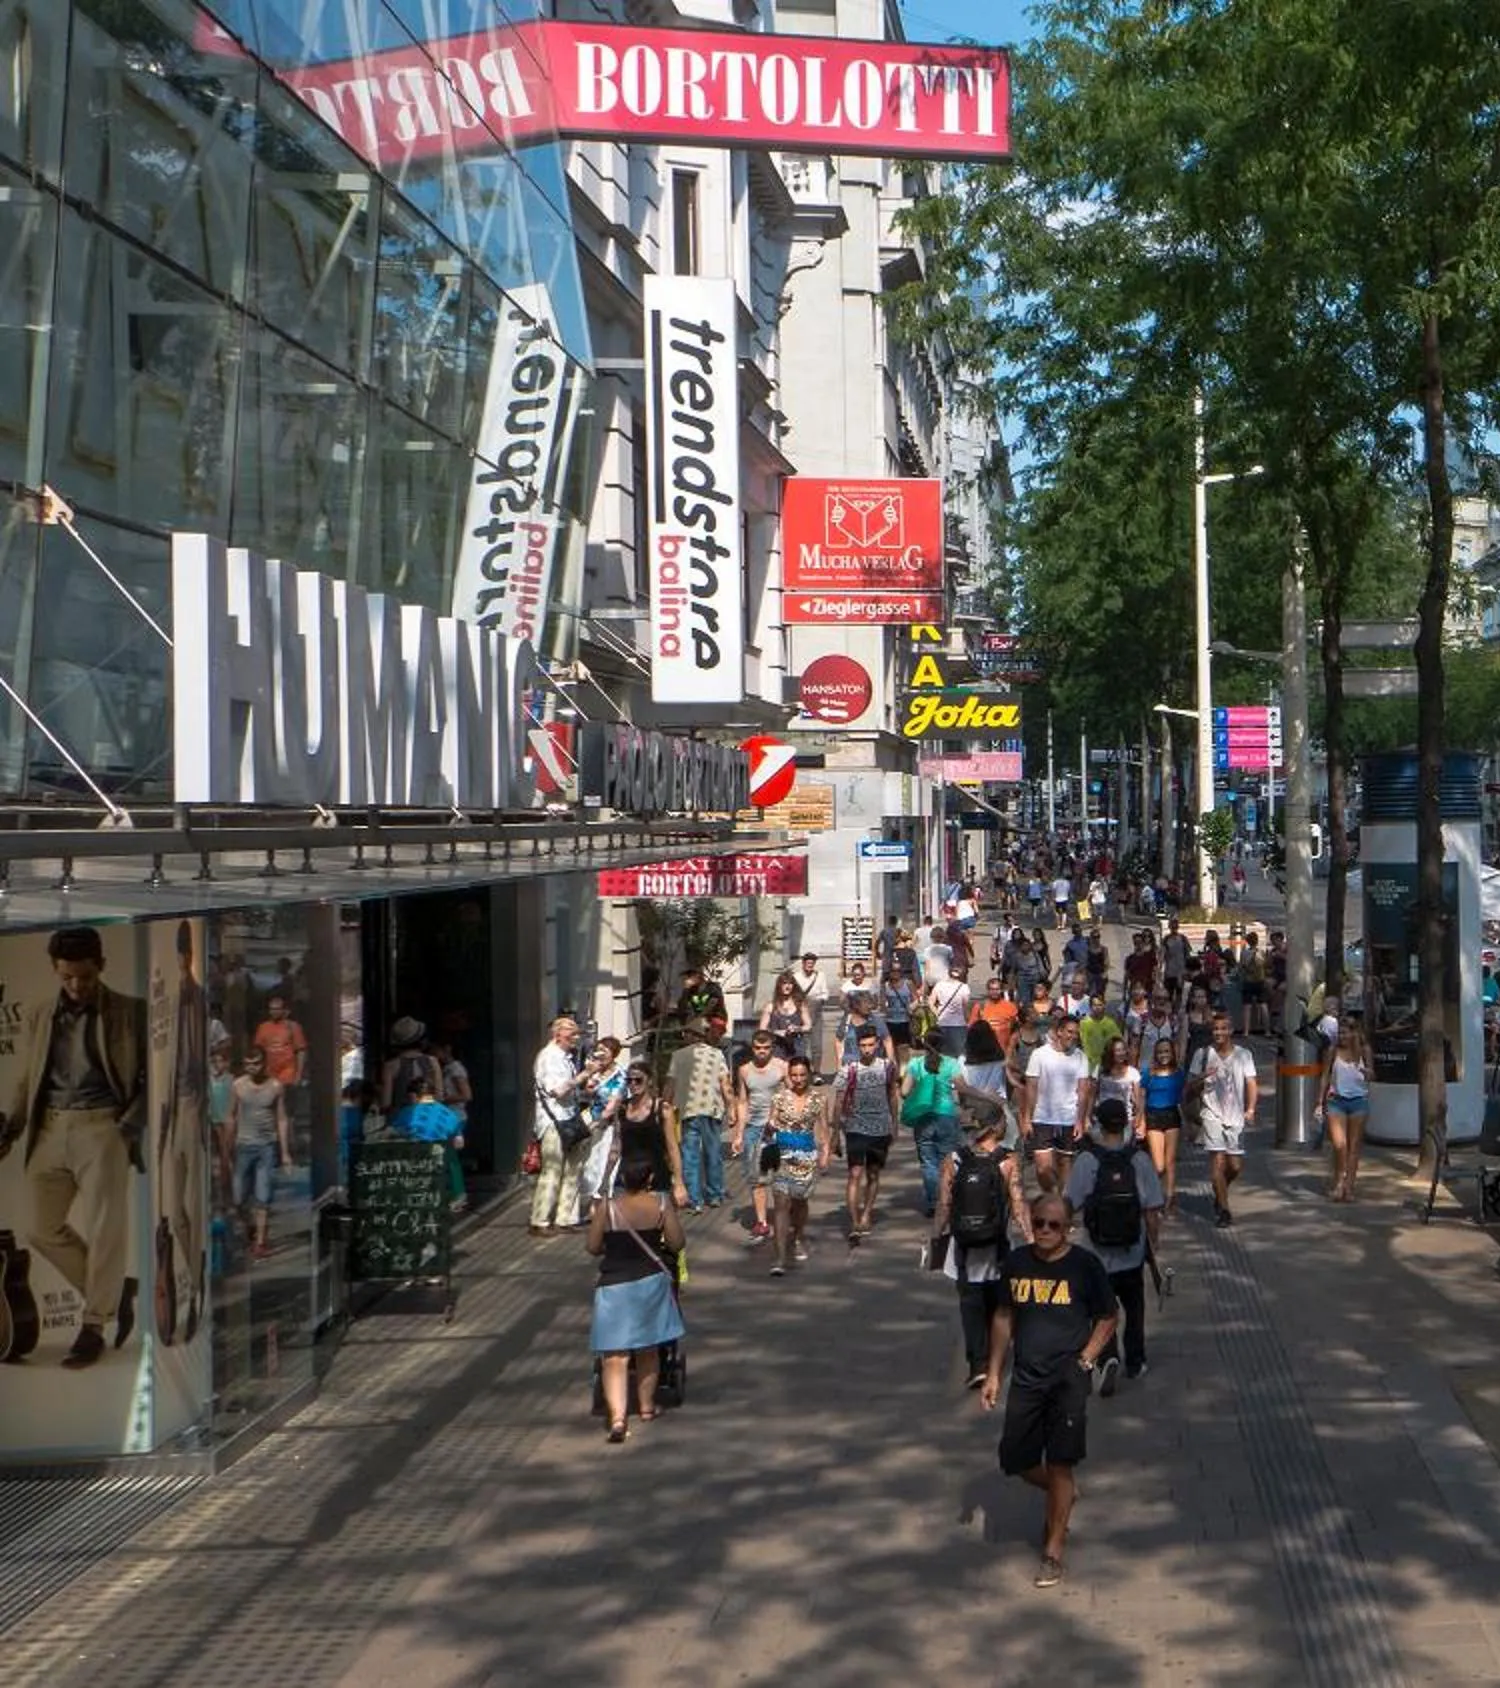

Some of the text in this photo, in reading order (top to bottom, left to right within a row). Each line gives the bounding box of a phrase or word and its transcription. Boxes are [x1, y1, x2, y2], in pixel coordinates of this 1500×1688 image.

[575, 40, 997, 137] BORTOLOTTI
[667, 315, 734, 671] trendstore
[657, 534, 688, 659] balina
[812, 598, 921, 619] Zieglergasse 1
[802, 684, 865, 695] HANSATON
[903, 695, 1021, 737] Joka
[624, 856, 784, 871] ELATERIA
[638, 872, 767, 896] BORTOLOTTI
